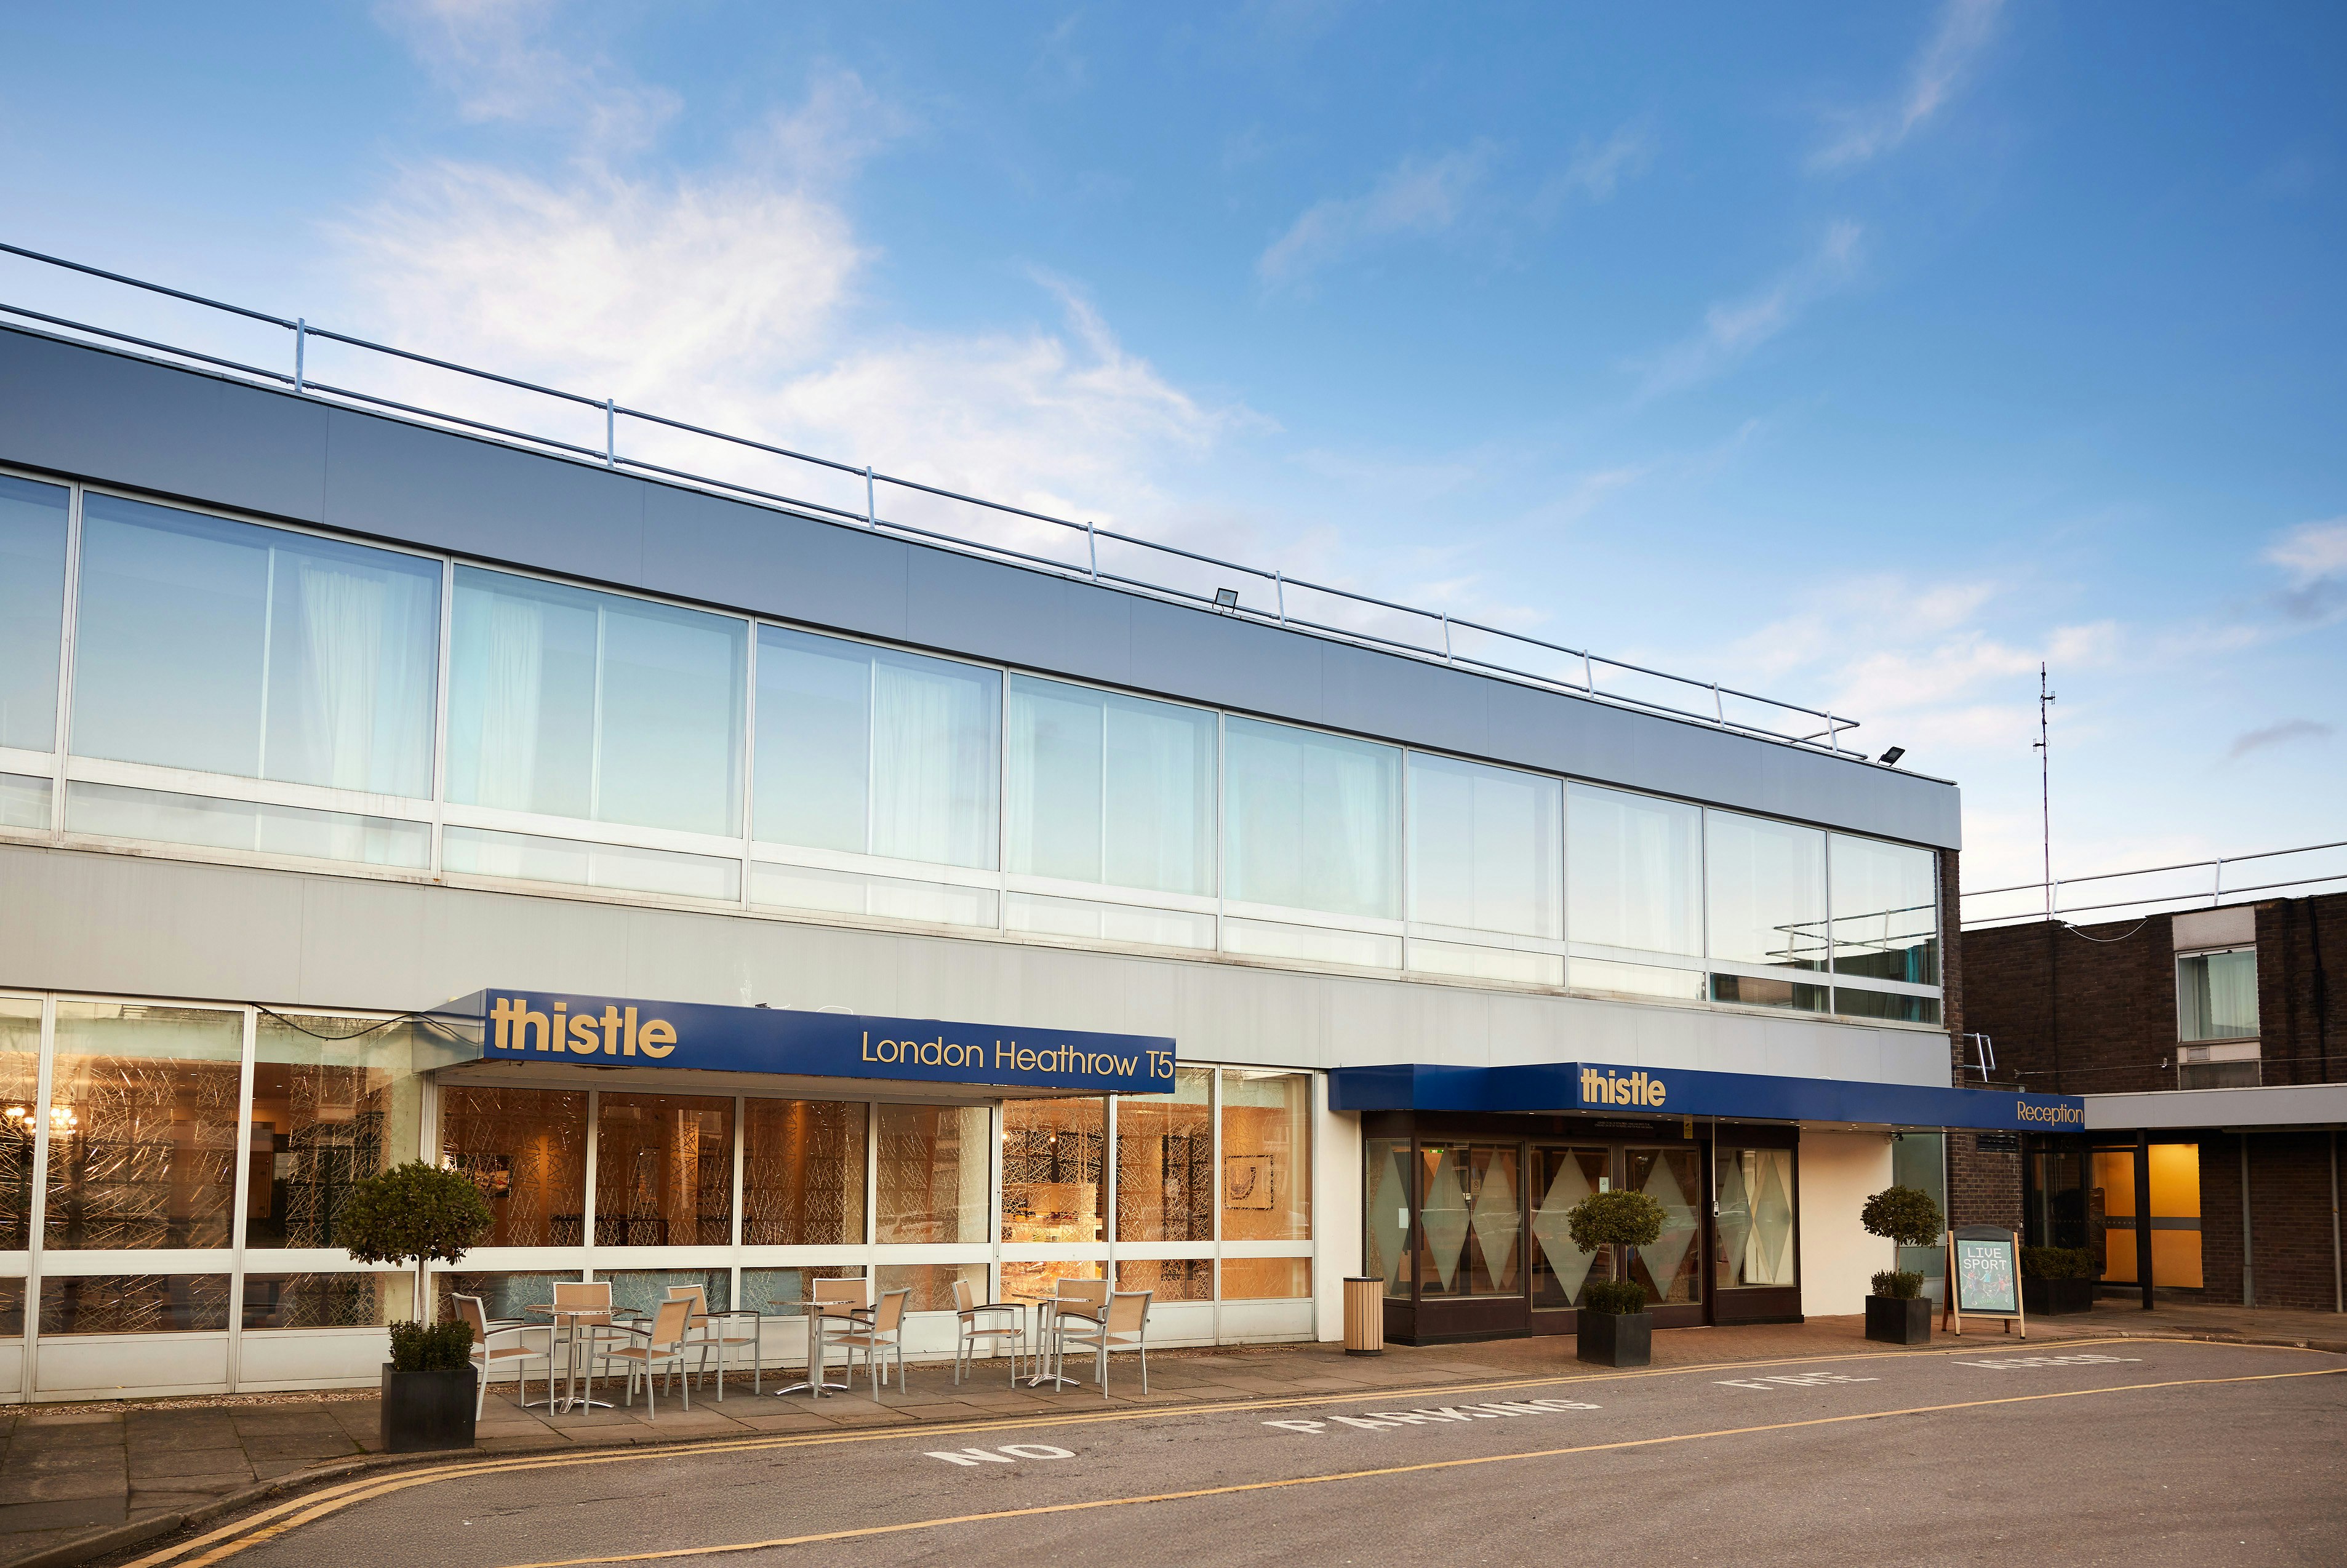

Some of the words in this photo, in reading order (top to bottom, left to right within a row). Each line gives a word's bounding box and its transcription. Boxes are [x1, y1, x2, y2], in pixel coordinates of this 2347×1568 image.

[490, 998, 677, 1058] thistle
[862, 1031, 984, 1068] London
[995, 1040, 1138, 1077] Heathrow
[1145, 1050, 1174, 1079] T5
[1580, 1068, 1666, 1107] thistle
[2017, 1101, 2084, 1127] Reception
[1963, 1258, 2007, 1271] SPORT
[1967, 1247, 2002, 1258] LIVE
[923, 1444, 1076, 1466] NO
[1260, 1399, 1604, 1434] PARKING
[1711, 1372, 1881, 1390] FIRE
